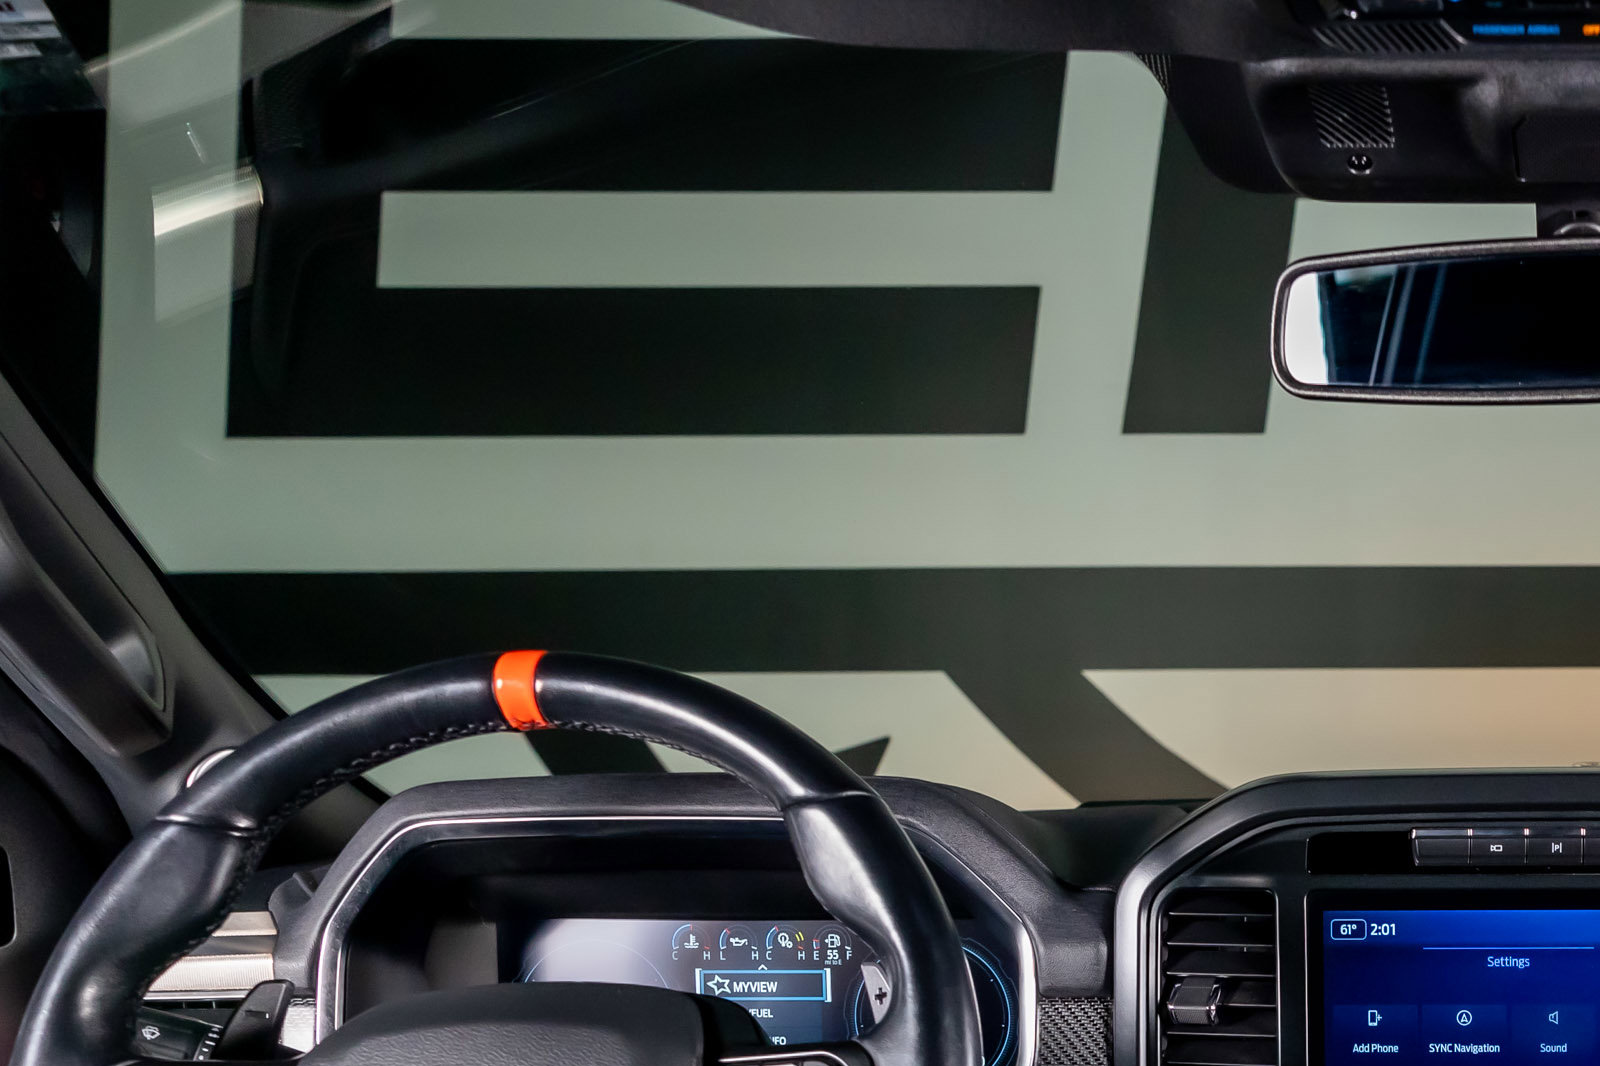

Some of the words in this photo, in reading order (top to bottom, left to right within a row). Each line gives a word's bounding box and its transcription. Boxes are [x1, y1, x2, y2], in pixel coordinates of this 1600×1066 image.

[1340, 922, 1358, 936] 61°
[1370, 923, 1396, 936] 2:01
[671, 950, 679, 961] C
[703, 950, 711, 961] H
[719, 950, 727, 961] L
[751, 950, 759, 961] H
[765, 950, 773, 961] C
[797, 950, 806, 961] H
[813, 950, 820, 961] E
[826, 951, 840, 960] 55
[846, 950, 853, 961] F
[1487, 955, 1531, 970] Settings
[732, 981, 778, 993] MYVIEW
[1352, 1043, 1370, 1053] Add
[1371, 1043, 1399, 1053] Phone
[1428, 1042, 1453, 1053] SYNC
[1453, 1043, 1501, 1055] Navigation
[1540, 1042, 1568, 1053] Sound
